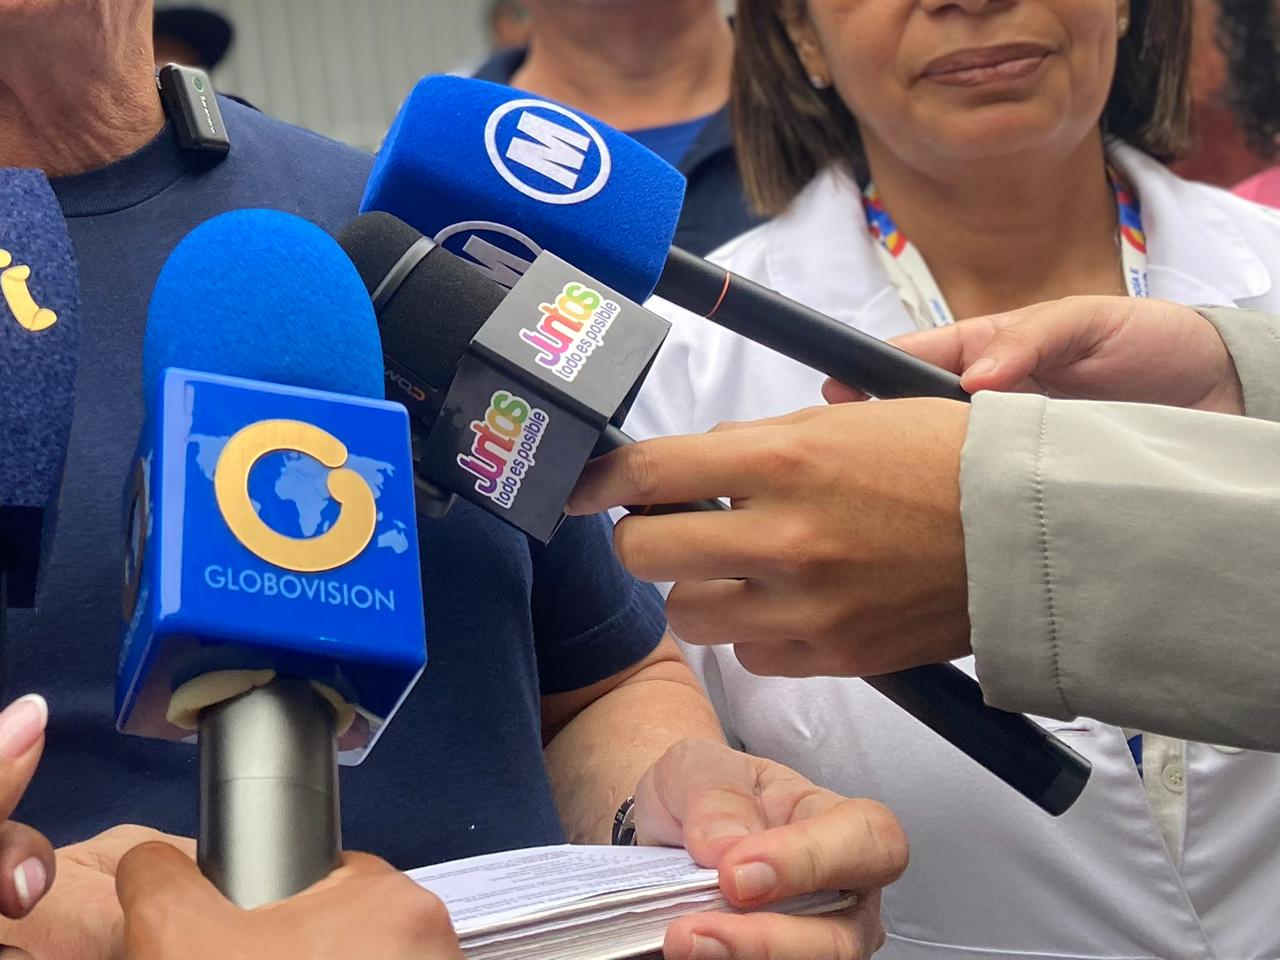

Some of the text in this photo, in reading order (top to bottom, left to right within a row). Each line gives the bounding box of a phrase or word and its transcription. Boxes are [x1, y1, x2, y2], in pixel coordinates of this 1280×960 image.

[505, 111, 591, 190] M
[522, 285, 601, 366] Juntos
[556, 302, 618, 379] todo es posible
[460, 394, 528, 494] Juntos
[495, 411, 546, 506] todo es posible
[204, 564, 396, 611] GLOBOVISION
